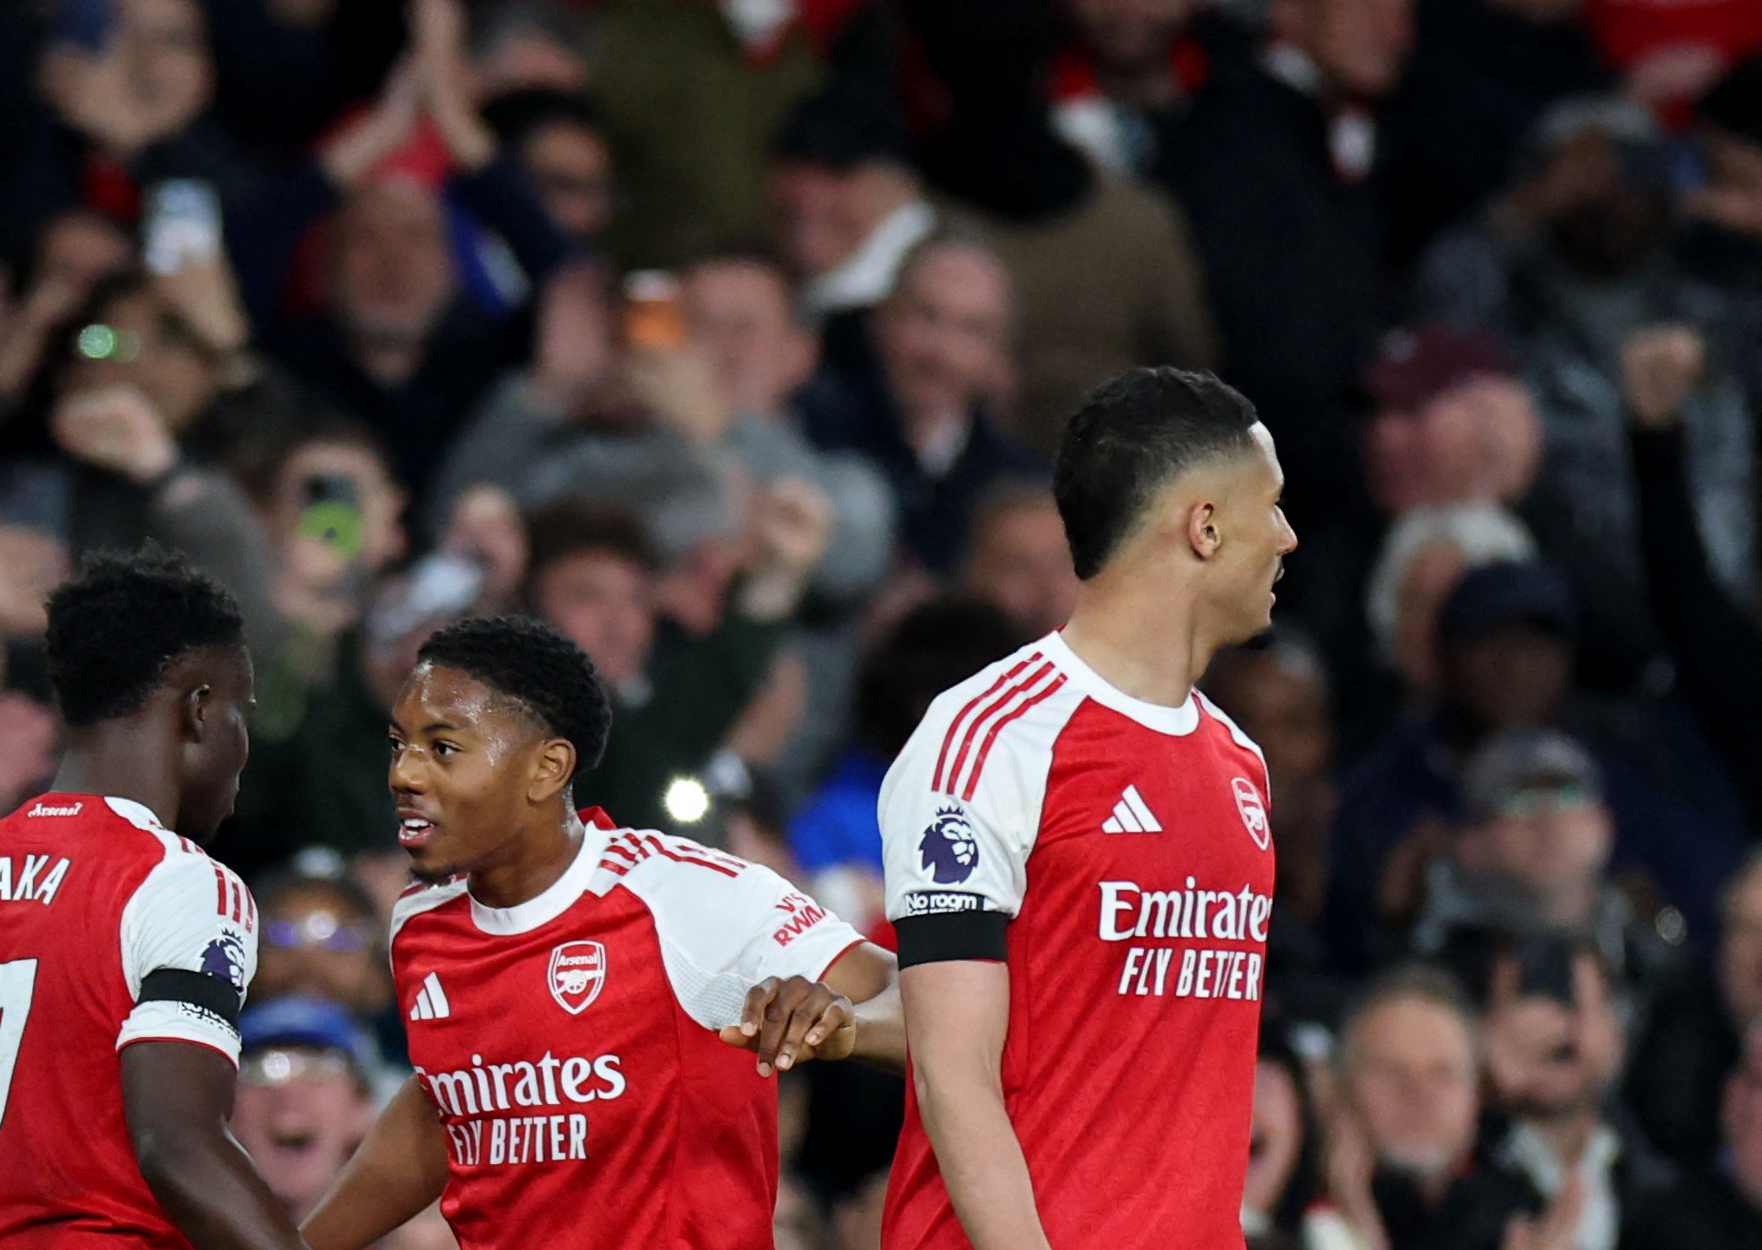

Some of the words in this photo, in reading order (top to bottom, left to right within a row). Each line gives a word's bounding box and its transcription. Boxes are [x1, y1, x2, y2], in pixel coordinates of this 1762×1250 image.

[27, 801, 84, 818] Arsenal
[904, 892, 928, 910] No
[929, 893, 978, 911] room
[1118, 946, 1173, 997] FLY
[1175, 948, 1263, 1002] BETTER
[447, 1119, 482, 1166] FLY
[489, 1113, 588, 1166] BETTER
